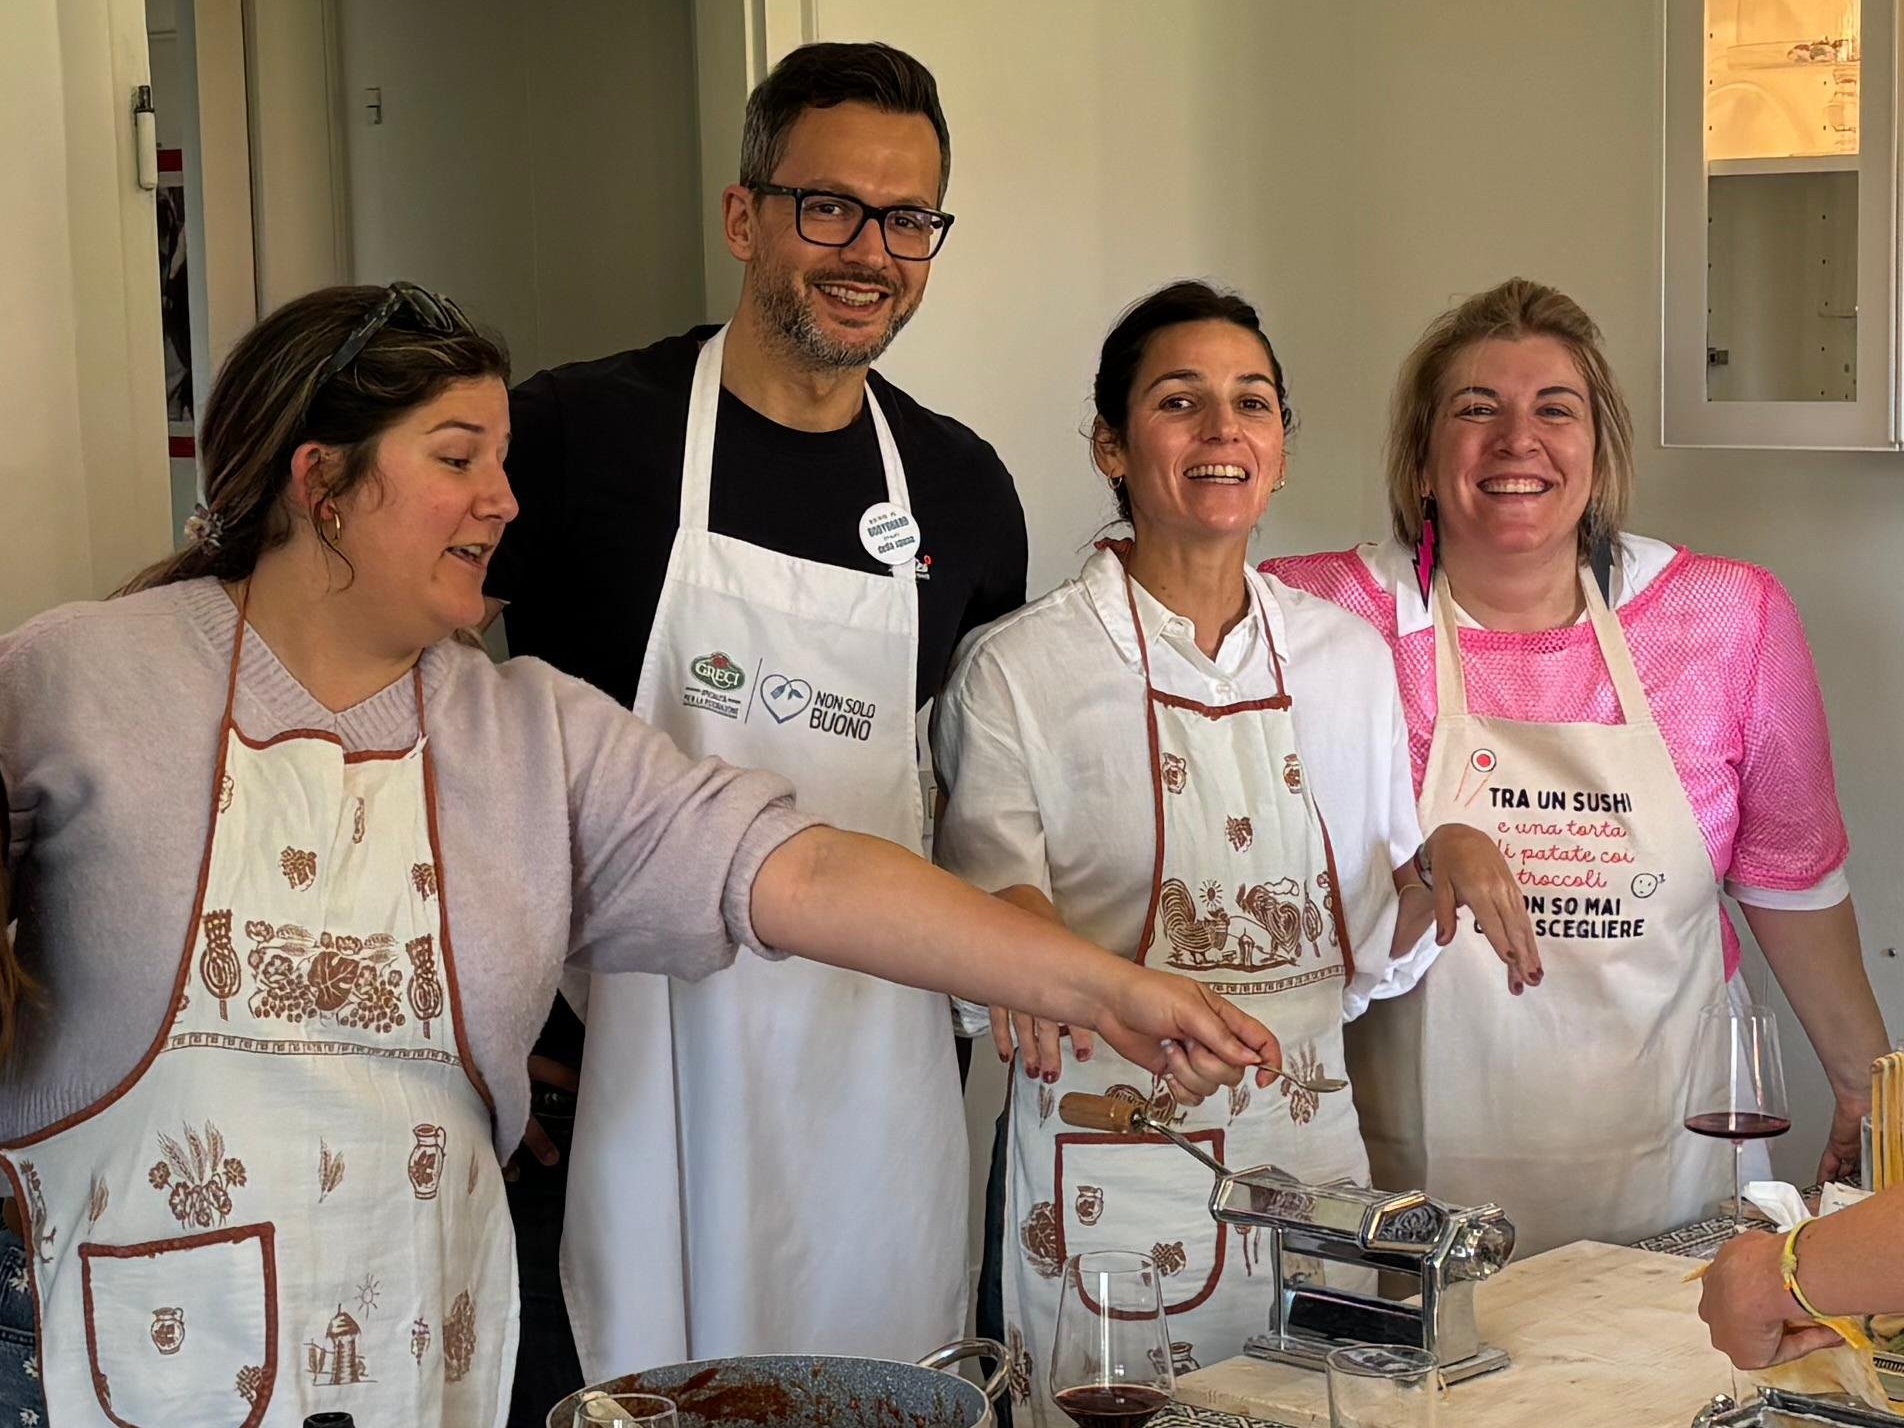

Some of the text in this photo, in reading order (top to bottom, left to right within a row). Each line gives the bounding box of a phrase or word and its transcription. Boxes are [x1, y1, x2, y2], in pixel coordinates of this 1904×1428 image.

[695, 659, 740, 689] GRECI
[814, 690, 877, 719] NON SOLO
[809, 708, 873, 742] BUONO
[1489, 787, 1633, 814] TRA UN SUSHI
[1497, 819, 1628, 838] e una torta
[1497, 839, 1636, 866] i patate coi
[1551, 896, 1578, 916] SO
[1585, 897, 1622, 917] MAI
[1535, 918, 1645, 940] SCEGLIERE
